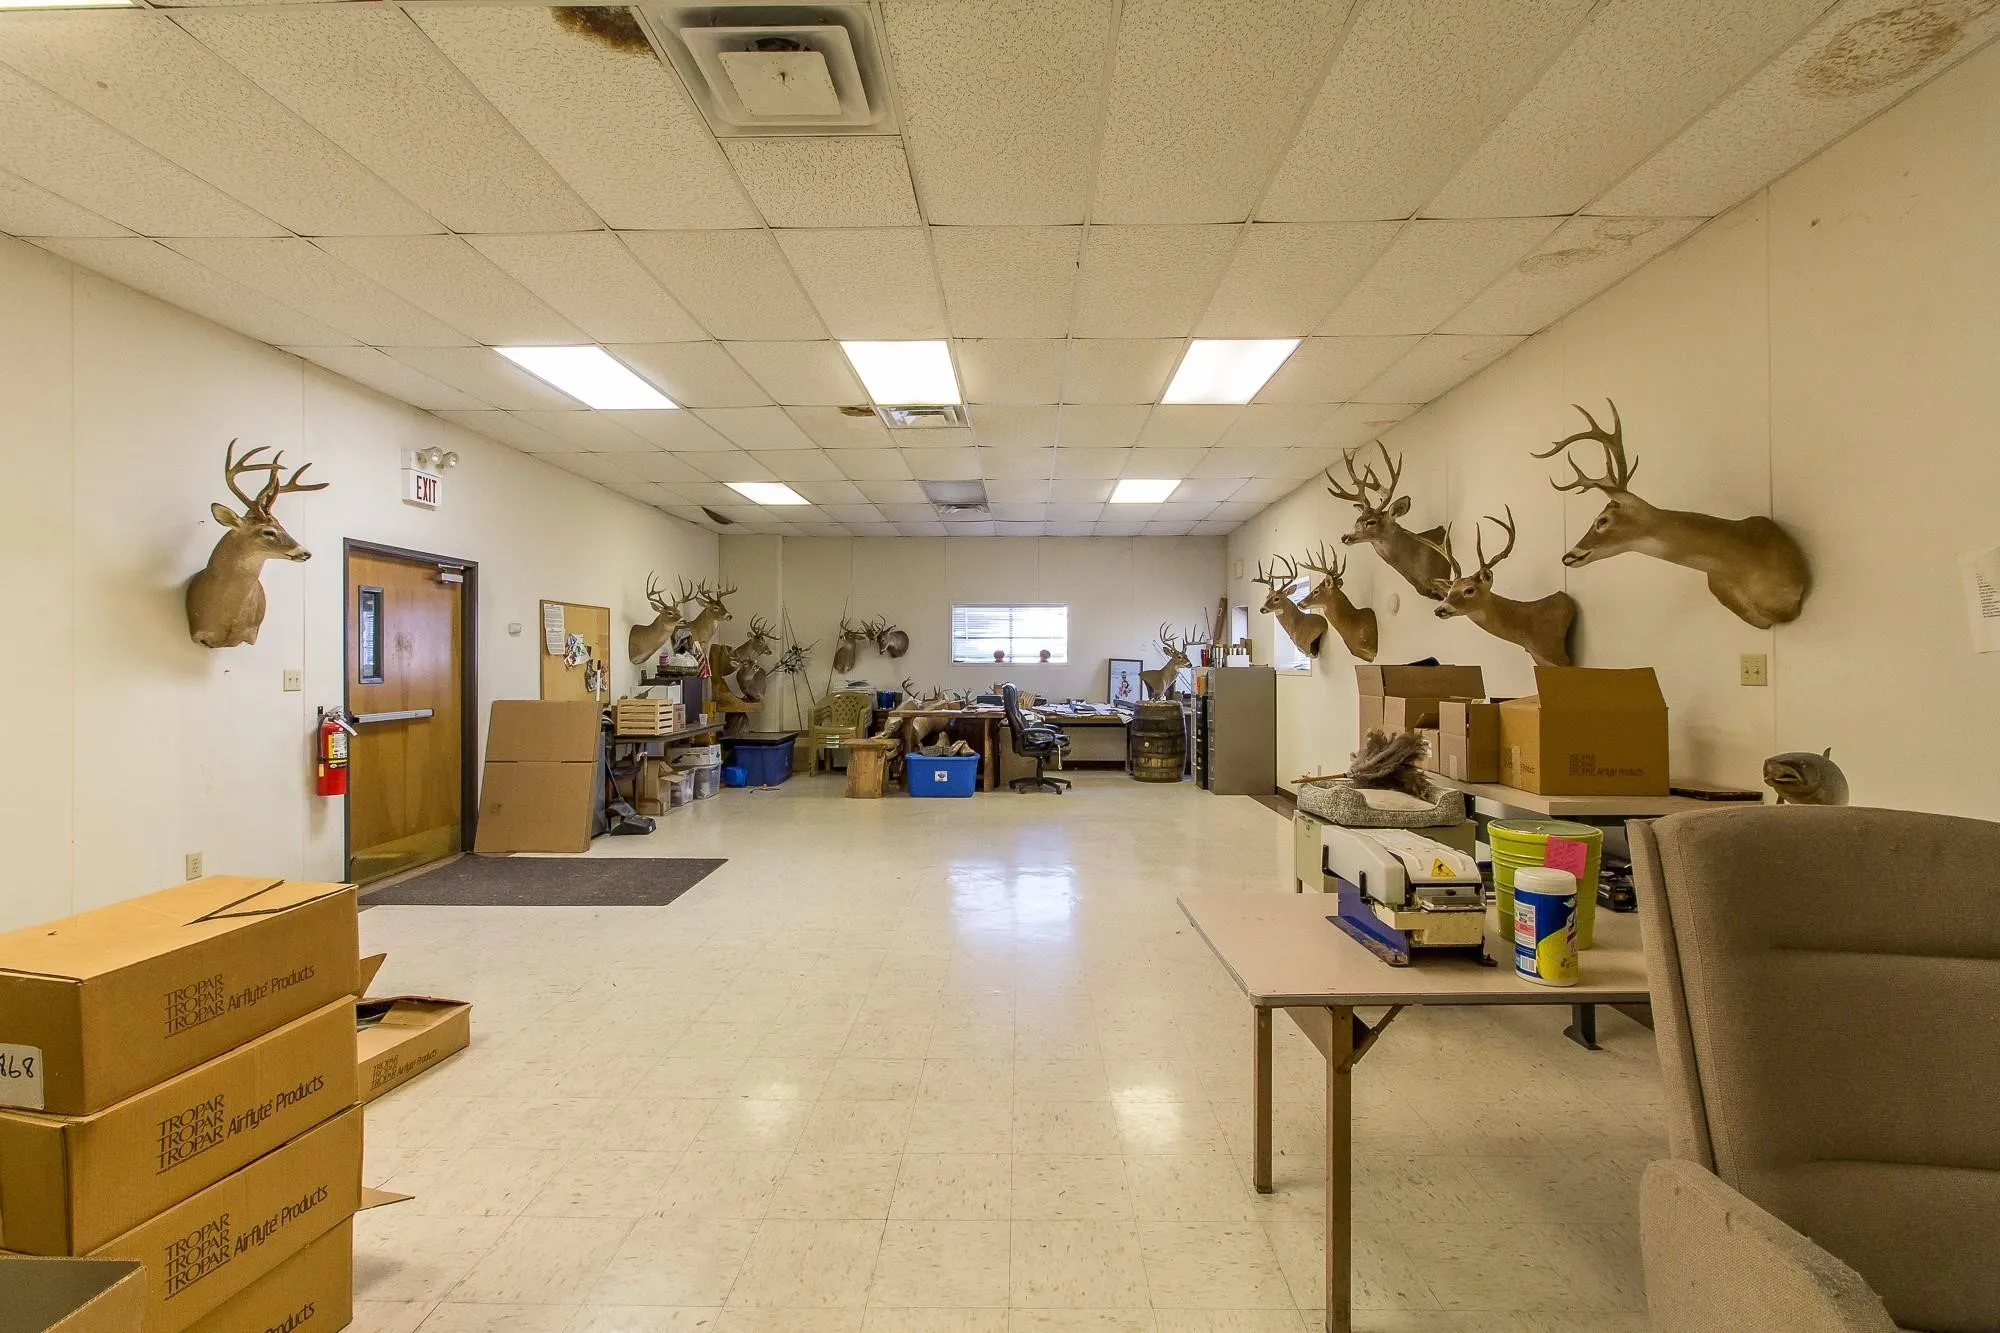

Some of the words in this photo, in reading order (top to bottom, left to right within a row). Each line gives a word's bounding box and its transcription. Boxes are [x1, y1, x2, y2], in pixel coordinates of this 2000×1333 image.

[416, 475, 437, 504] EXIT
[164, 974, 224, 1006] TROPAR
[164, 1001, 225, 1034] TROPAR
[271, 965, 315, 993] Products
[164, 987, 224, 1020] TROPAR
[157, 1094, 224, 1136] TROPAR
[157, 1126, 224, 1169] TROPAR
[276, 1075, 324, 1112] Products
[157, 1110, 224, 1153] TROPAR
[164, 1245, 231, 1294] TROPAR
[281, 1184, 328, 1227] Products
[165, 1213, 231, 1259] TROPAR
[165, 1228, 231, 1274] TROPAR
